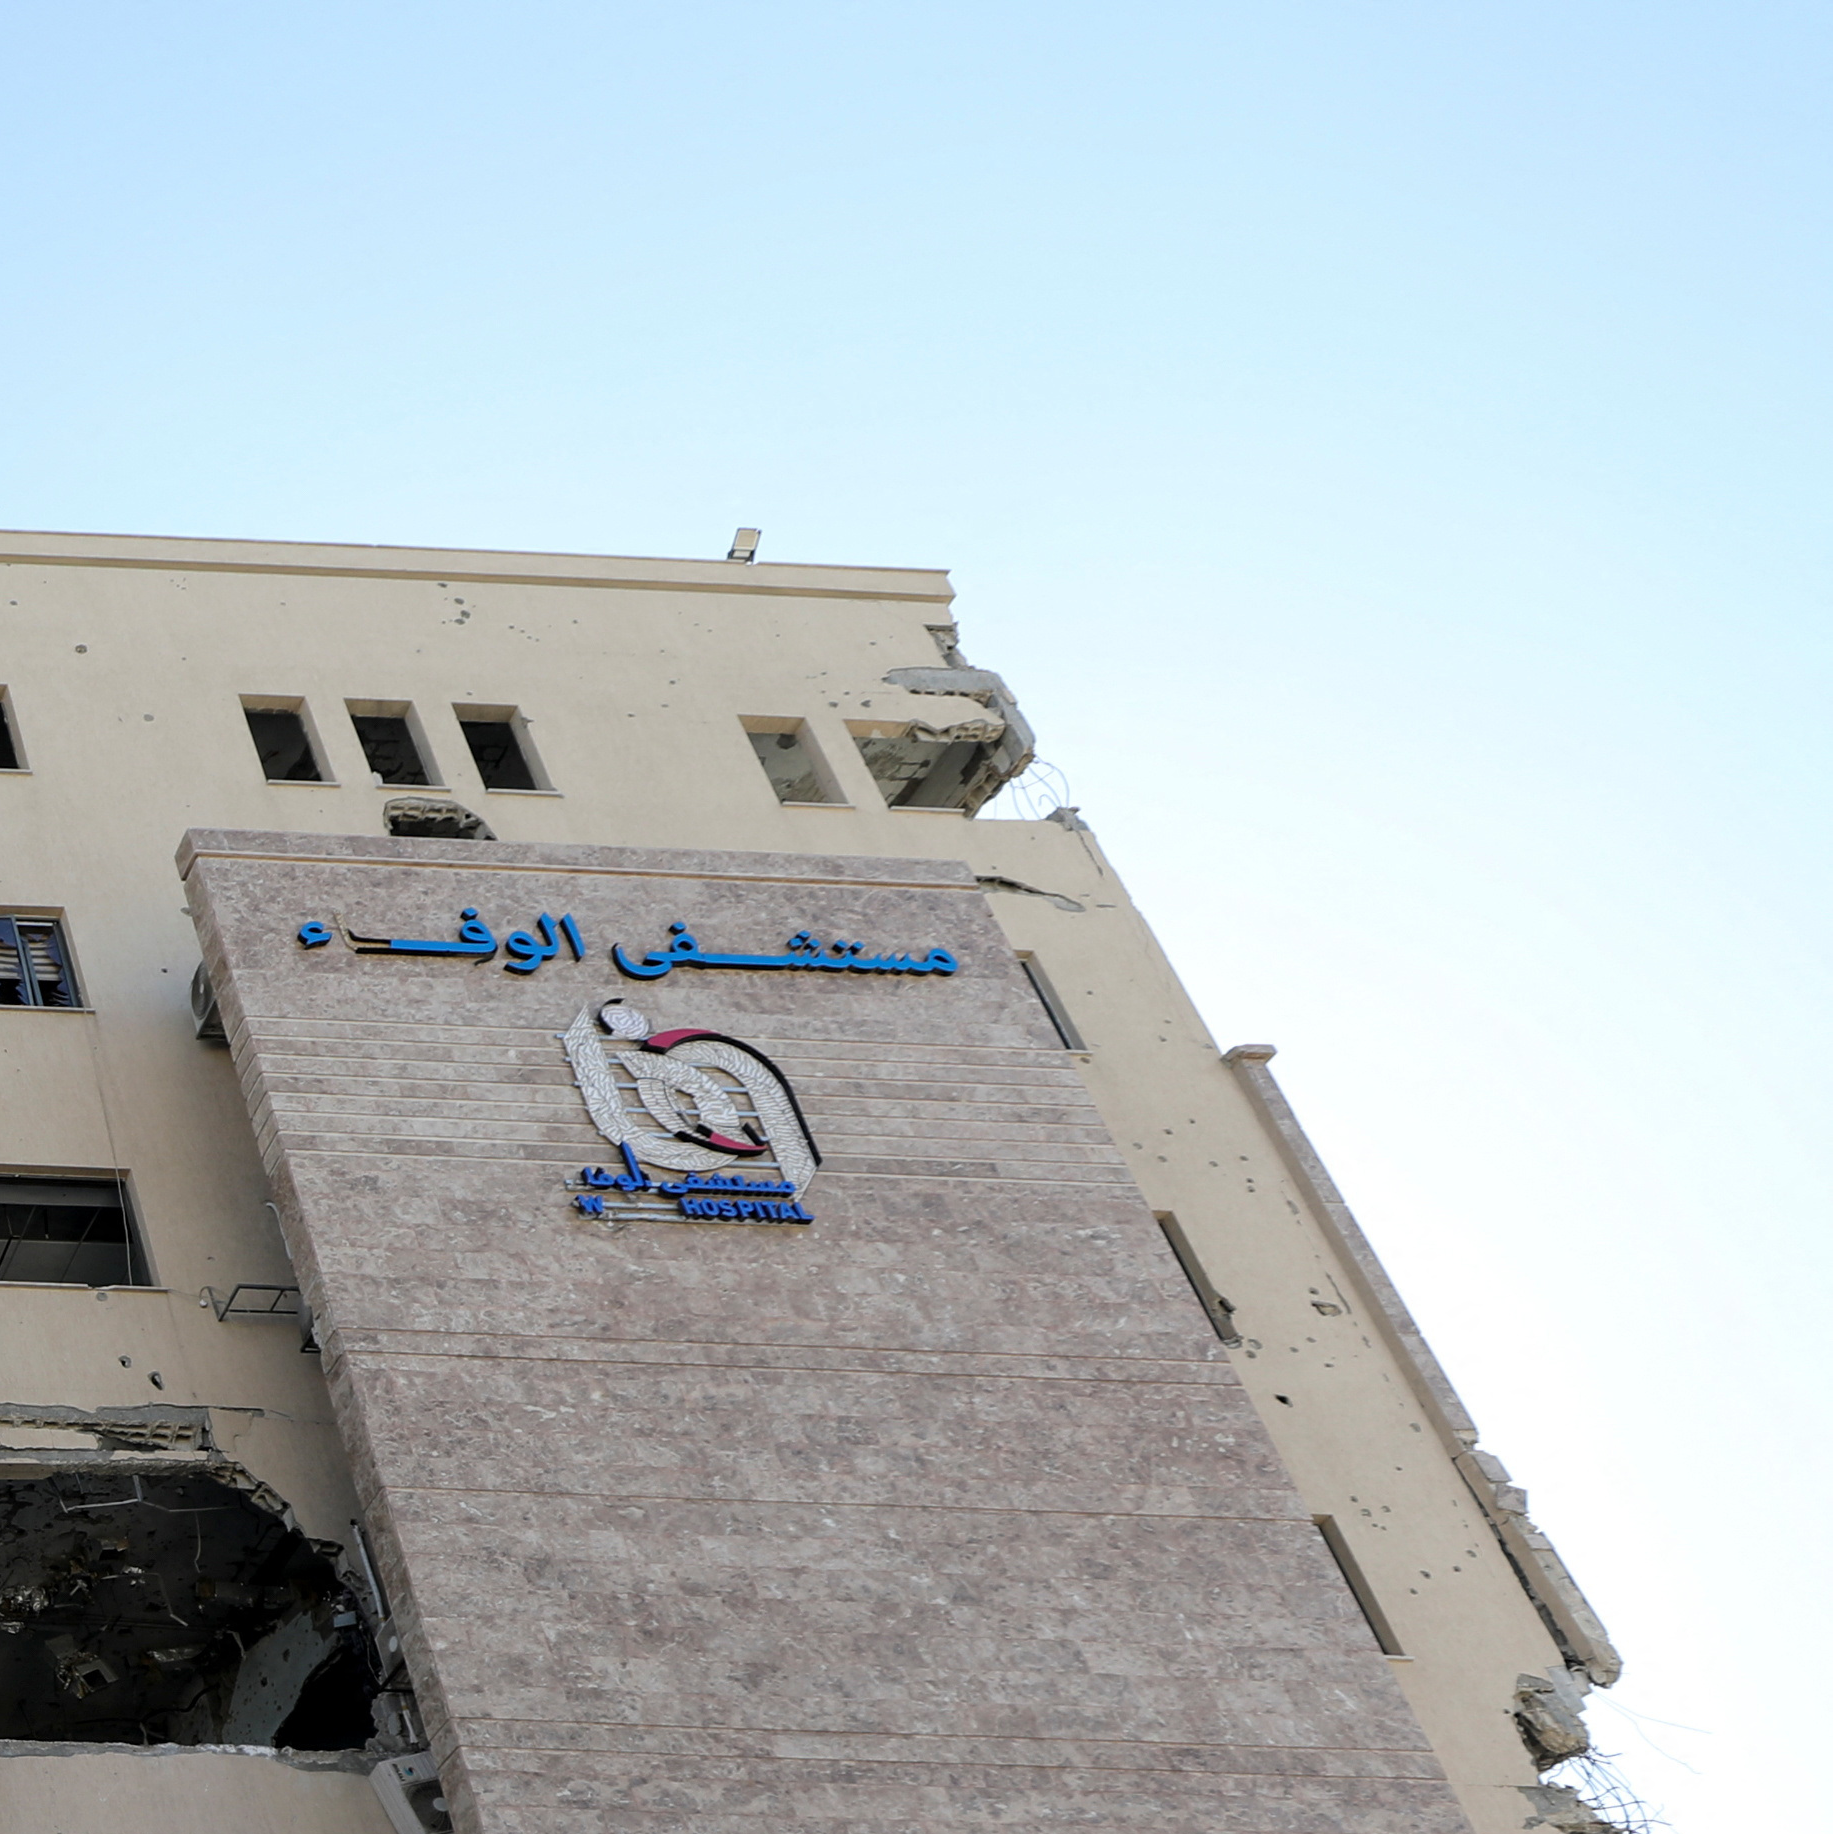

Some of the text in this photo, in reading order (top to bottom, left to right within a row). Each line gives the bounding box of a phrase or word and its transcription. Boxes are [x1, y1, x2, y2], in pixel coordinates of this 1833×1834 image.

[611, 921, 958, 981] مستشفى
[659, 1171, 797, 1198] مستشفى
[679, 1197, 815, 1224] HOSPITAL
